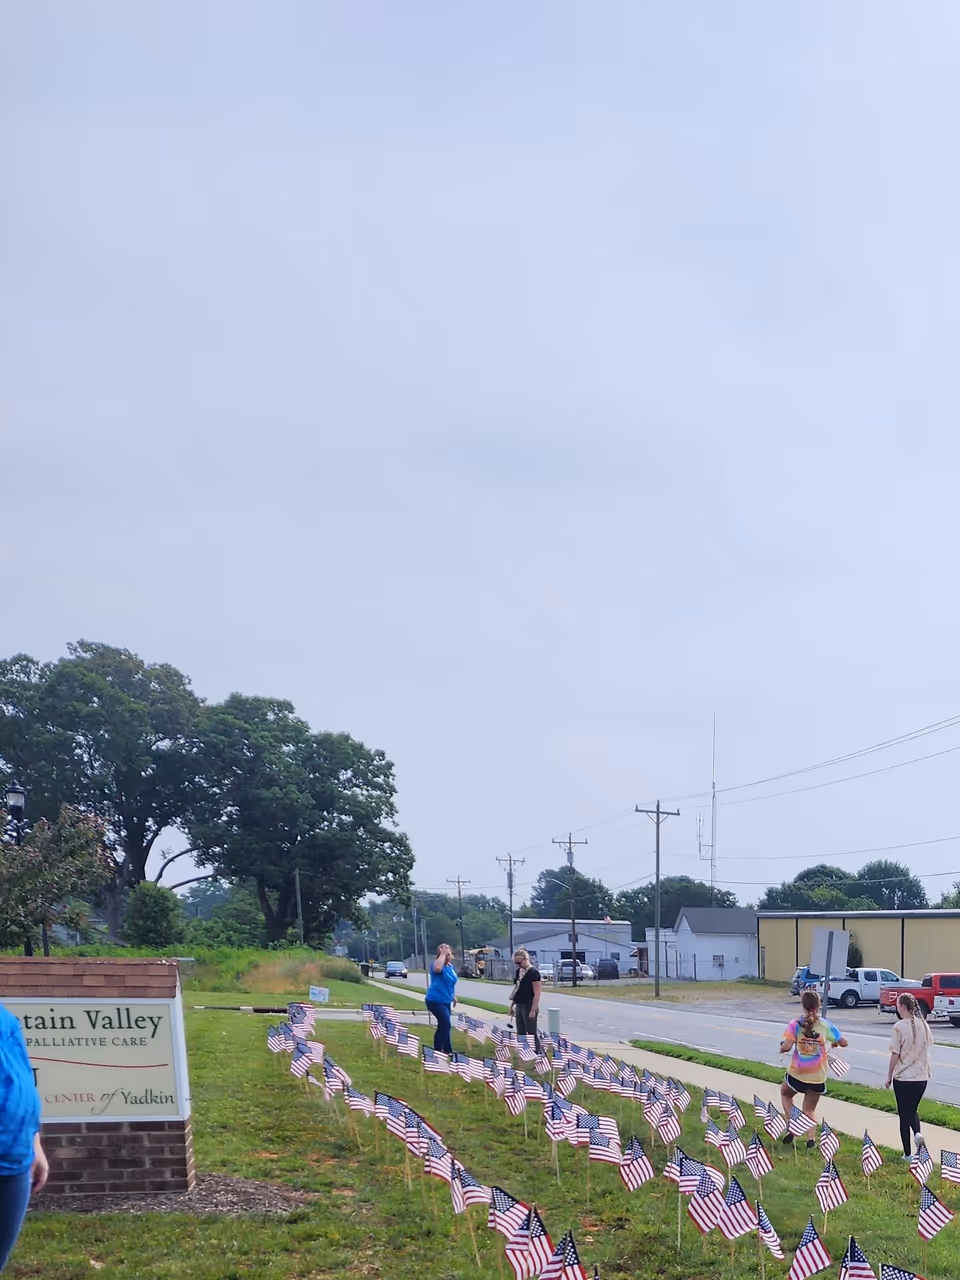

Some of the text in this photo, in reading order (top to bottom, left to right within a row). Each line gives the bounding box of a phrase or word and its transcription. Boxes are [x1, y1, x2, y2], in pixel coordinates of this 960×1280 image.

[82, 1007, 163, 1039] Valley
[25, 1037, 148, 1047] PALLIATIVE CARE
[44, 1087, 175, 1115] CENTER of Yadkin
